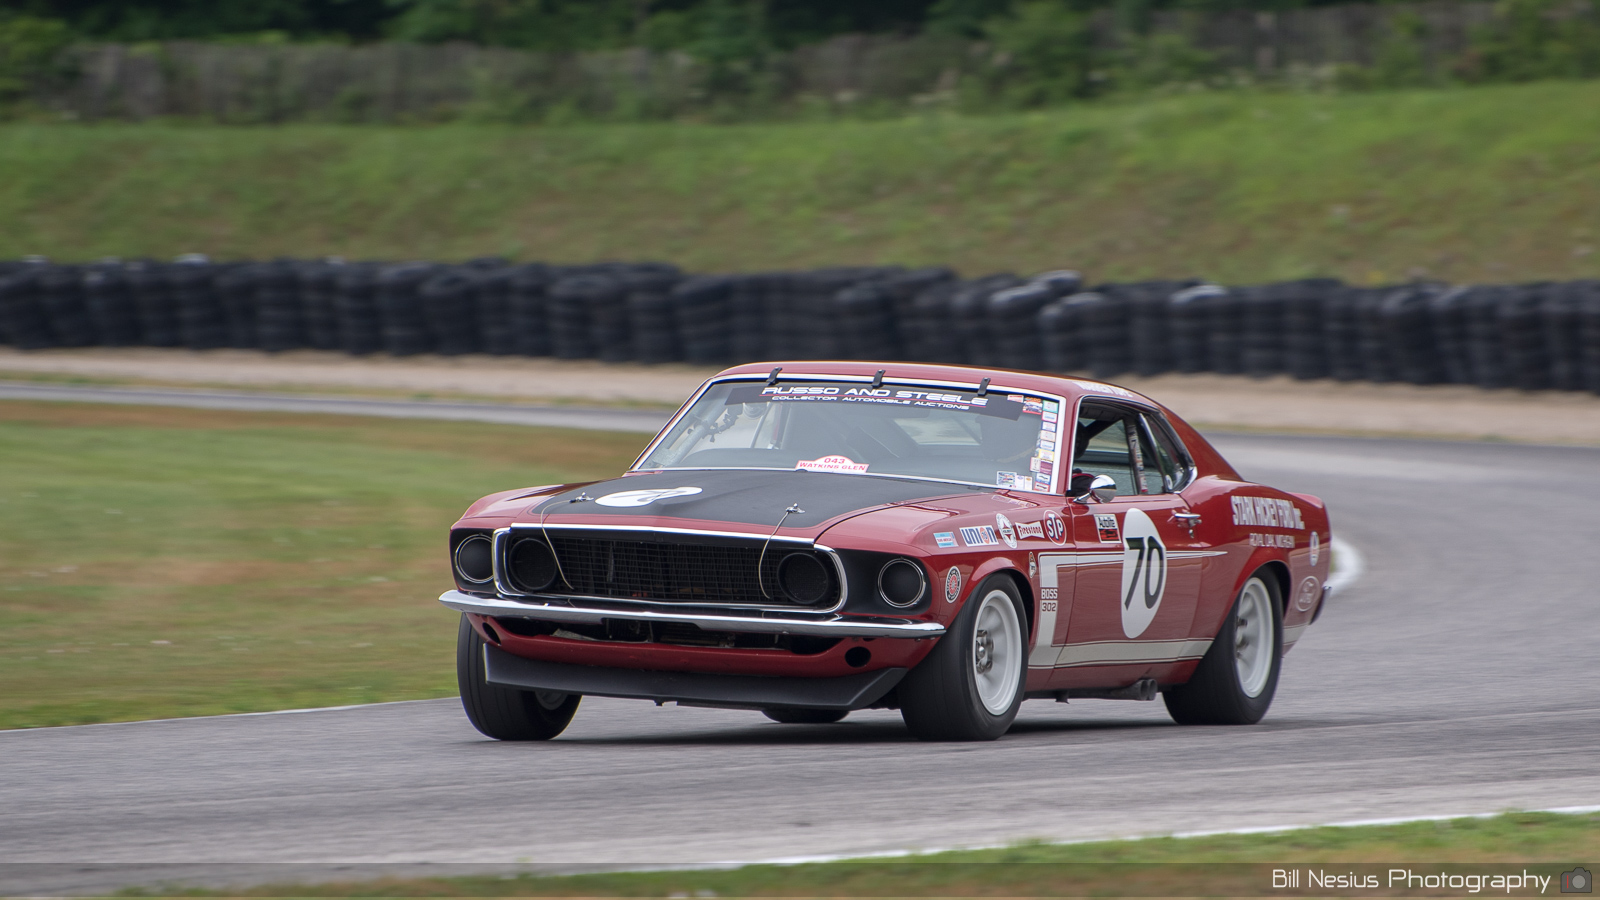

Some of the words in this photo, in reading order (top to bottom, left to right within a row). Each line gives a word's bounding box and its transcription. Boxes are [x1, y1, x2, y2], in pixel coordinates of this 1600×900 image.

[761, 386, 840, 395] RUSSO
[844, 387, 891, 397] AND
[895, 390, 989, 406] STEELE
[842, 396, 911, 405] AUTOMOBILE
[914, 401, 970, 410] AUCTIONS
[1017, 524, 1042, 537] Firestone
[1045, 512, 1064, 541] STP
[1124, 535, 1165, 611] 70
[1041, 588, 1058, 600] BOSS
[1041, 602, 1057, 612] 302
